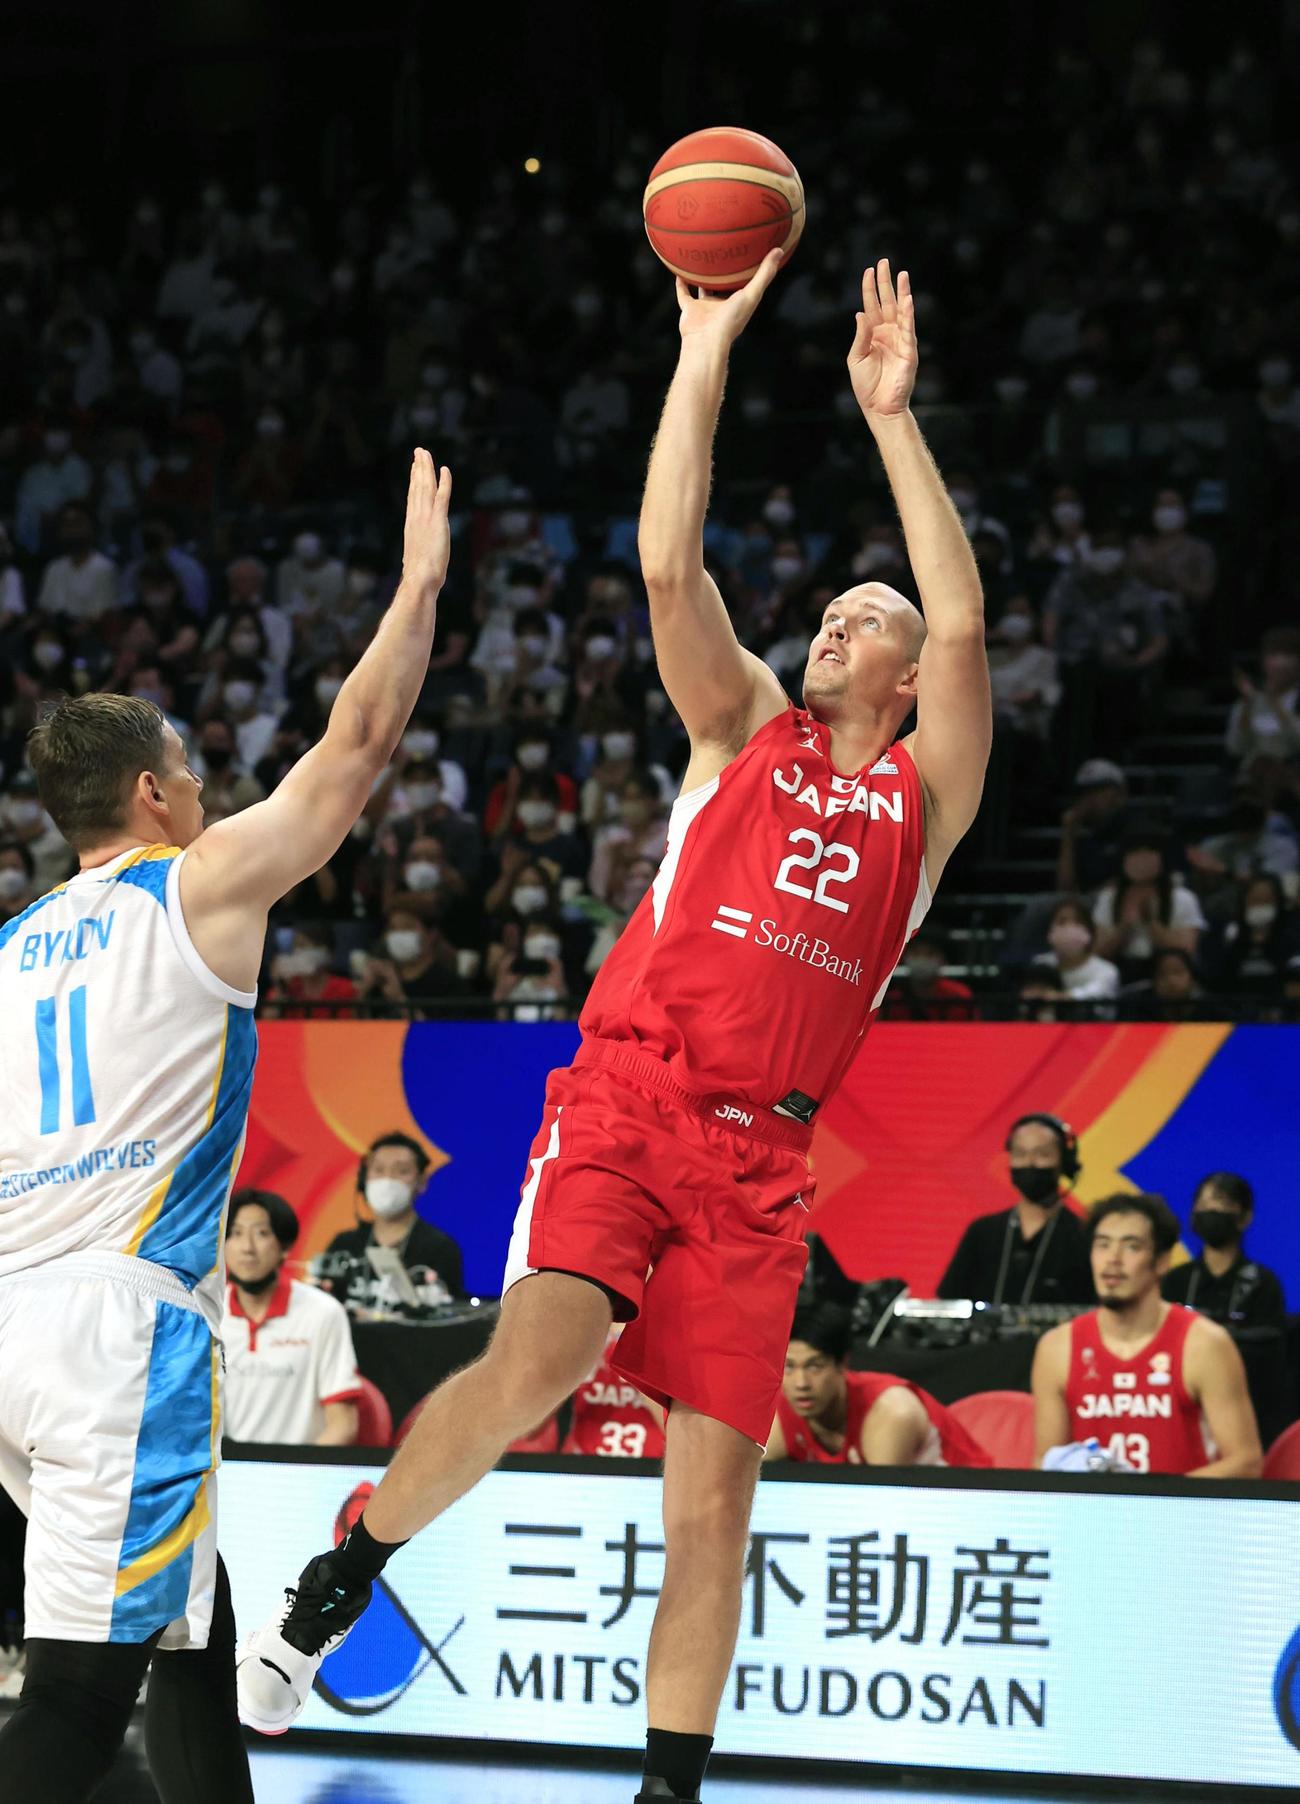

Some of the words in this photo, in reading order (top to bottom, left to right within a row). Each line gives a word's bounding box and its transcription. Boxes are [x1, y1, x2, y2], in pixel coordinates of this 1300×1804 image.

[773, 763, 904, 823] JAPAN
[774, 828, 860, 914] 22
[754, 919, 863, 986] SoftBank
[36, 984, 96, 1135] 11
[715, 1104, 754, 1128] JPN
[583, 1382, 646, 1408] JAP
[1076, 1394, 1172, 1419] JAPAN
[596, 1421, 647, 1457] 33
[496, 1523, 1050, 1649] 三井不動産
[496, 1651, 642, 1706] MITS
[734, 1664, 1046, 1728] FUDOSAN
